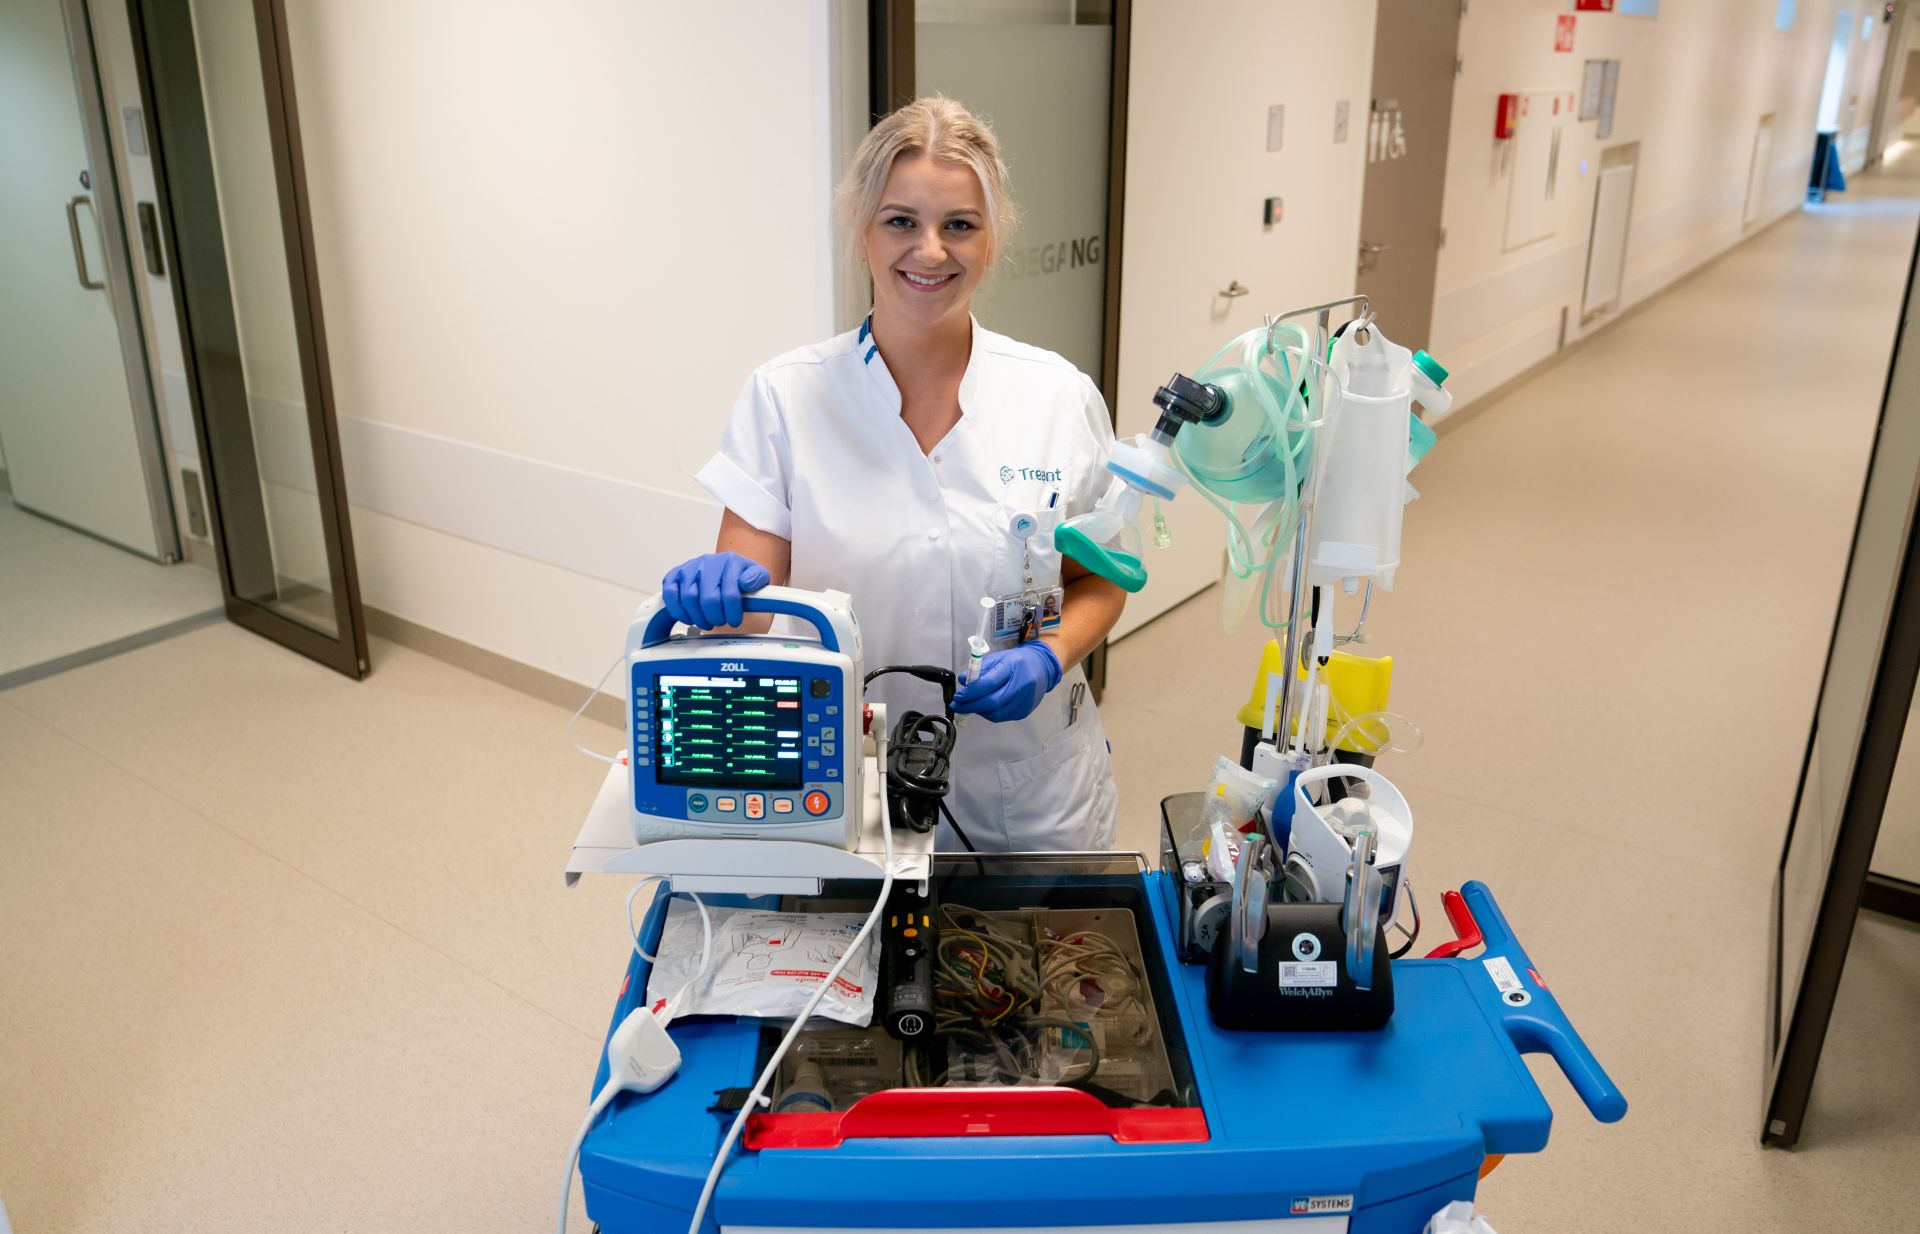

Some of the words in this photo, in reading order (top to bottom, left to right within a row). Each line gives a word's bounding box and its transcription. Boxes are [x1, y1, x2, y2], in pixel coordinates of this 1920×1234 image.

[1019, 468, 1061, 482] Treant
[720, 662, 746, 672] ZOLL
[1310, 1199, 1350, 1209] SYSTEMS
